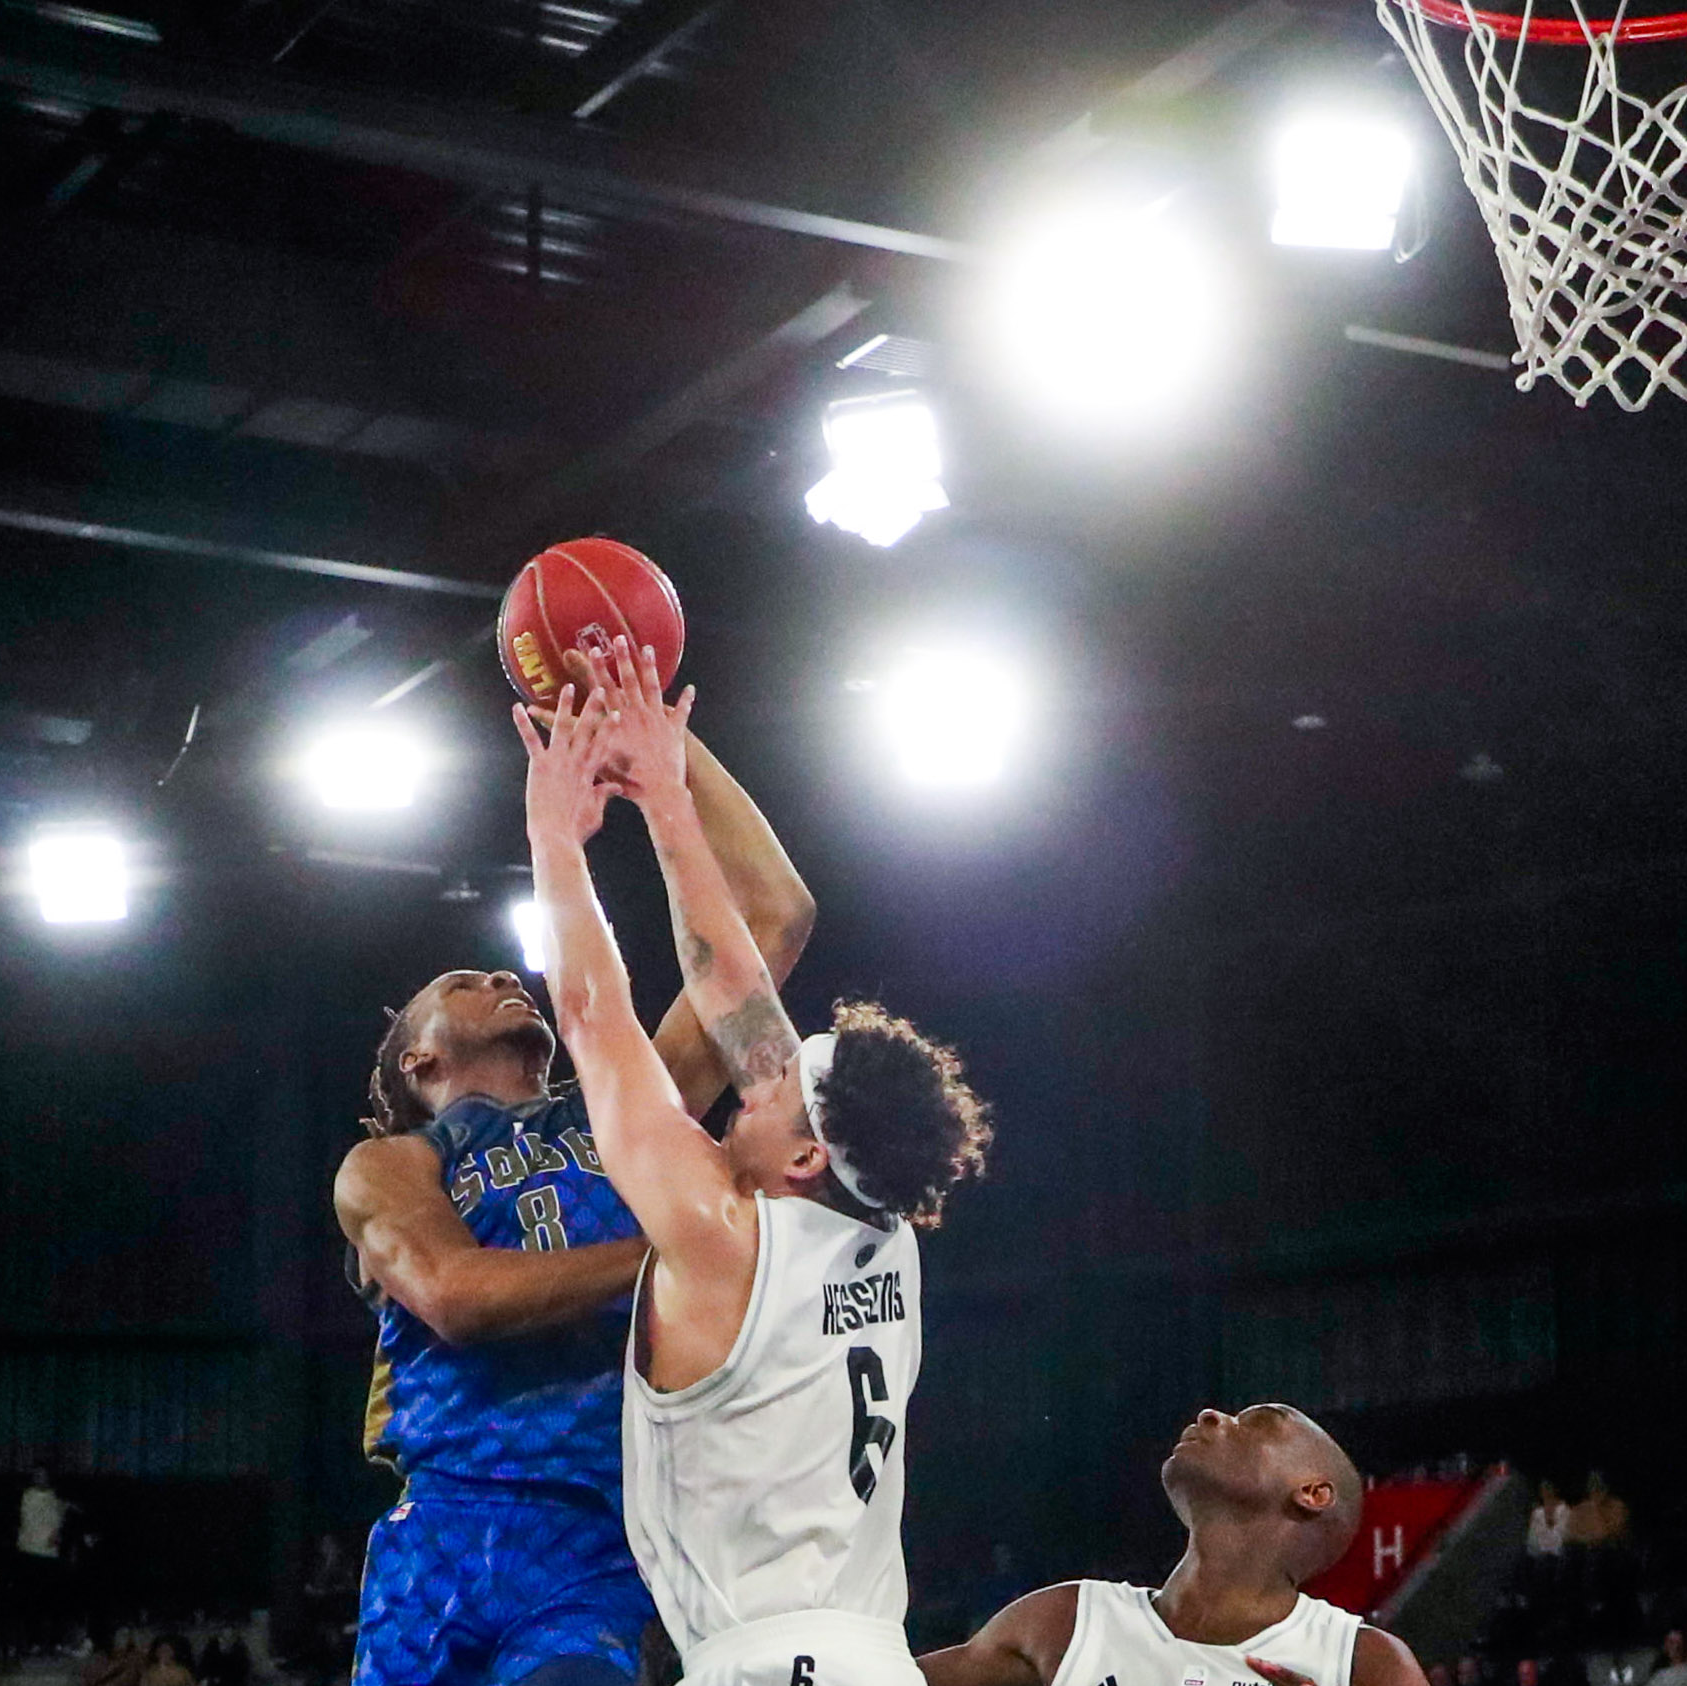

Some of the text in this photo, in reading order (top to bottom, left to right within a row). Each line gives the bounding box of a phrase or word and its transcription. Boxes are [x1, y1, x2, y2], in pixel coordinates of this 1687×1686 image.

[515, 1185, 568, 1251] 8
[846, 1346, 896, 1506] 6
[1373, 1523, 1403, 1580] H
